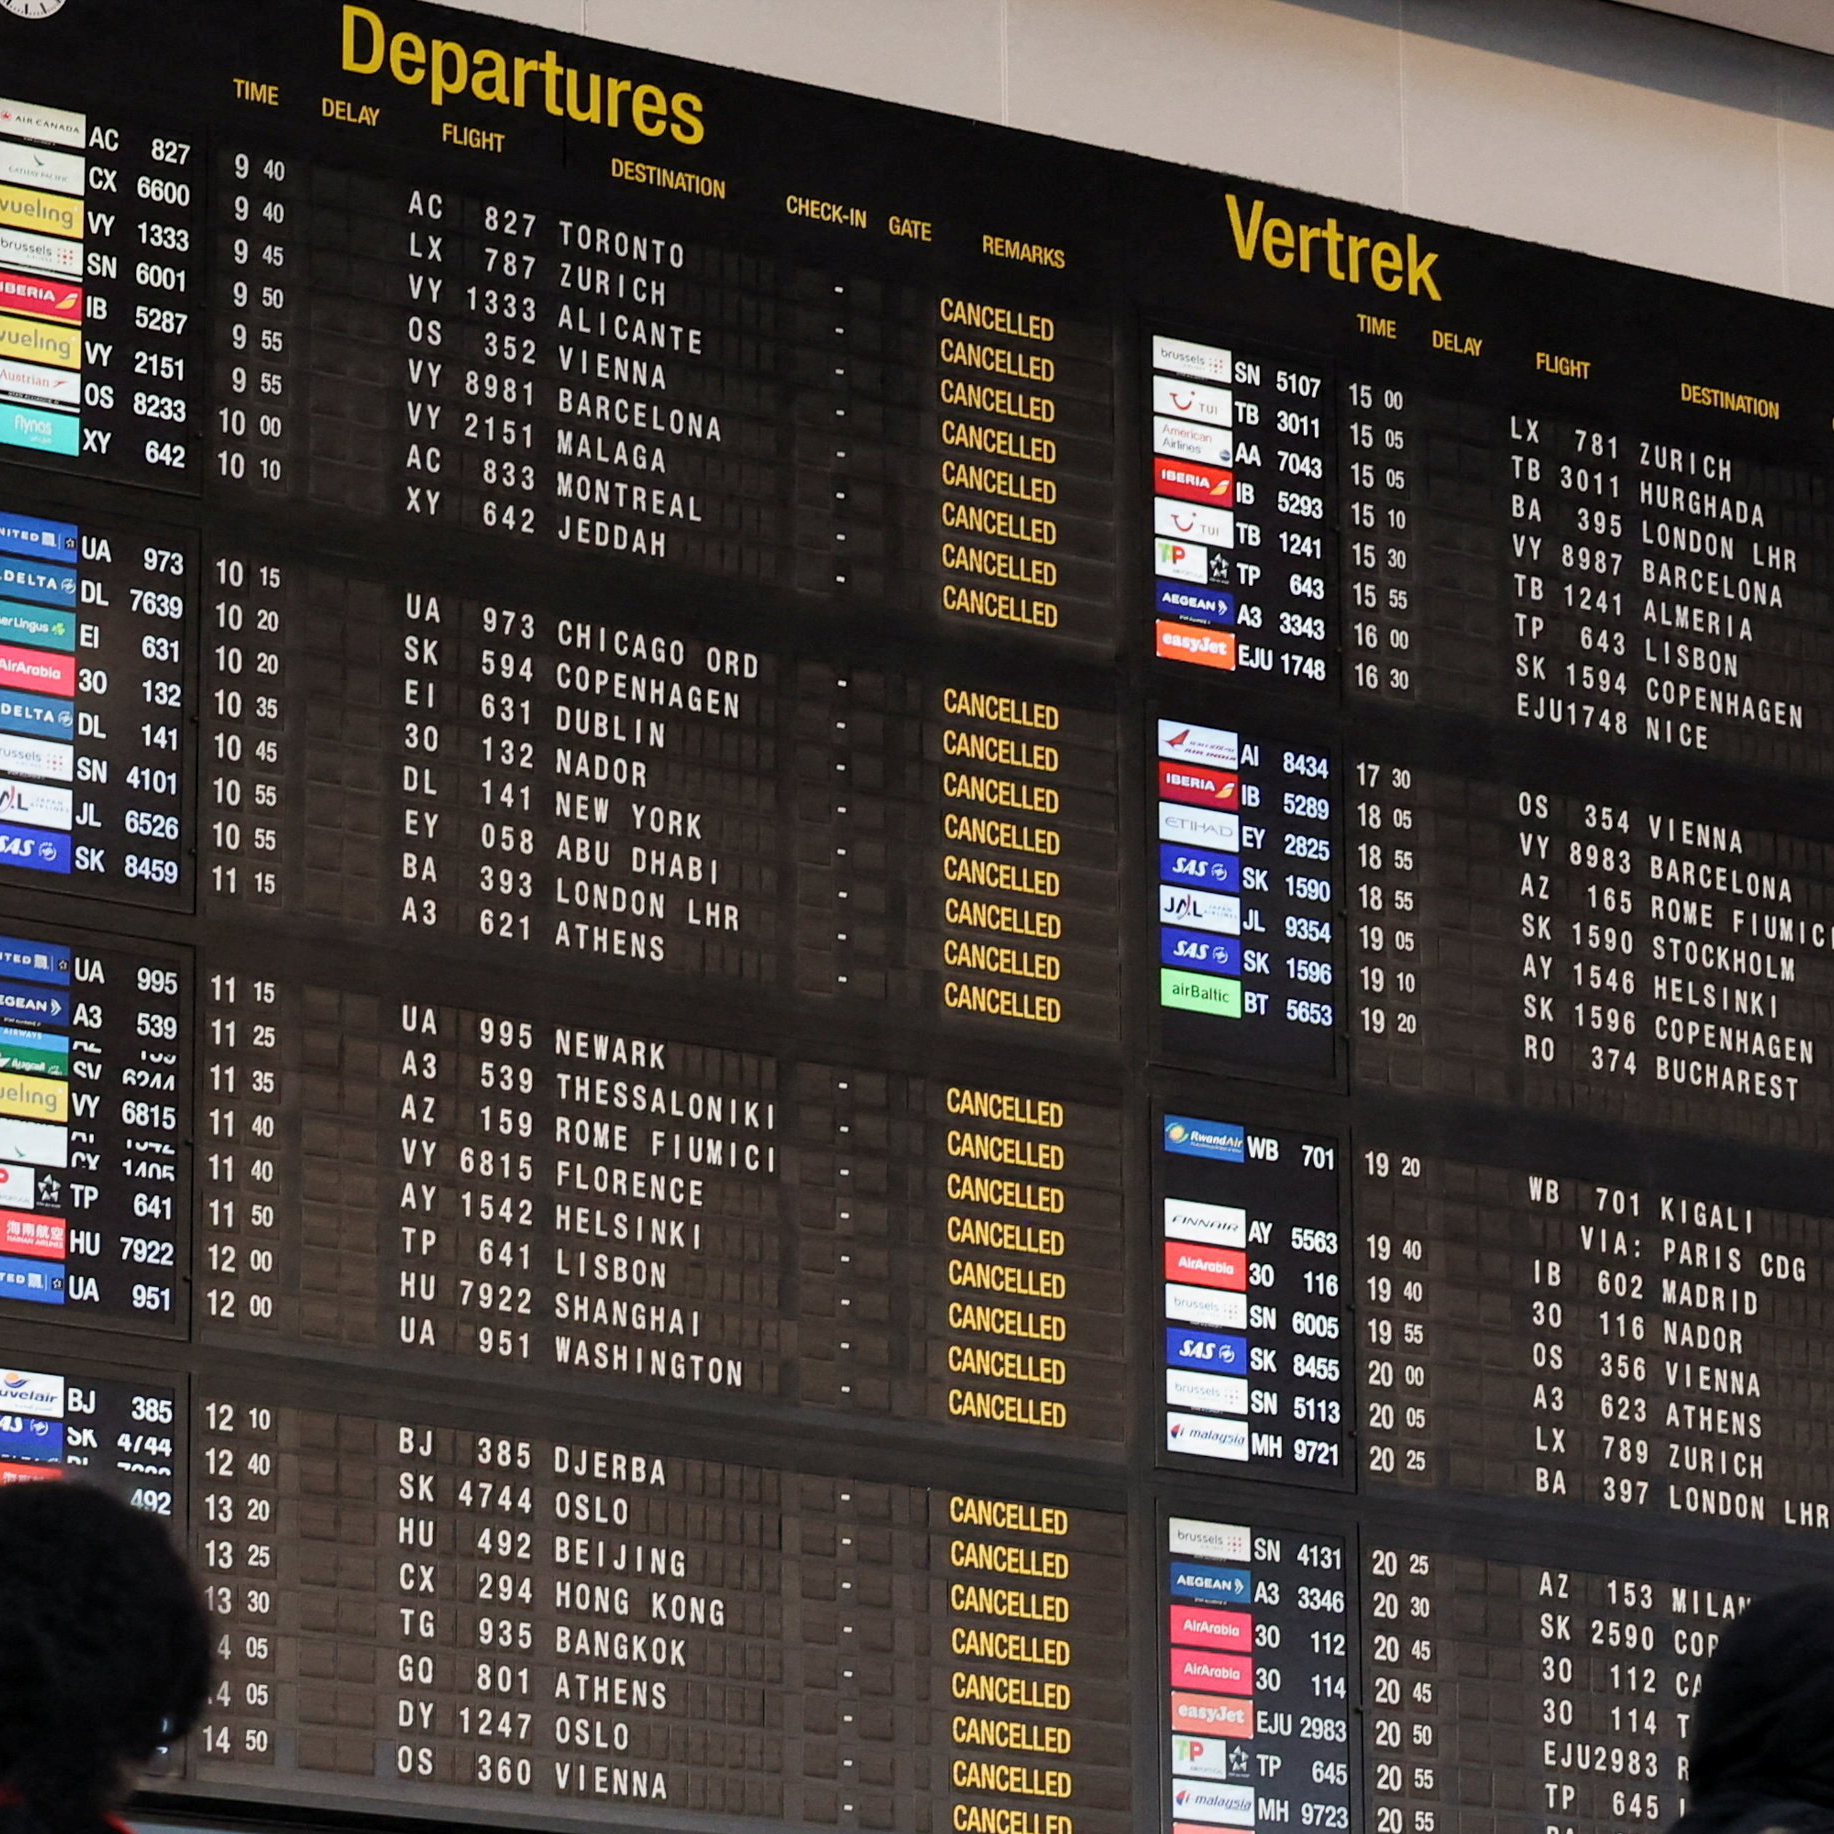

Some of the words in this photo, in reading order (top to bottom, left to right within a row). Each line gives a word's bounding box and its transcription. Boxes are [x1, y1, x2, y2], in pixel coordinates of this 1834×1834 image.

[343, 5, 704, 144] Departures
[89, 127, 118, 151] AC
[152, 139, 190, 164] 827
[233, 79, 278, 105] TIME
[322, 98, 379, 126] DELAY
[443, 123, 505, 152] FLIGHT
[612, 158, 725, 199] DESTINATION
[787, 195, 866, 228] CHECK-IN
[889, 216, 931, 241] GATE
[983, 235, 1065, 268] REMARKS
[0, 198, 74, 229] vueling
[0, 238, 52, 257] brussels
[235, 154, 248, 178] 9
[264, 160, 284, 181] 40
[409, 191, 442, 219] AC
[486, 206, 535, 237] 827
[559, 221, 683, 268] TORONTO
[941, 298, 1053, 341] CANCELLED
[1225, 194, 1441, 301] Vertrek
[0, 281, 55, 302] IBERIA
[561, 263, 664, 306] ZURICH
[559, 305, 701, 354] ALICANTE
[559, 346, 665, 389] VIENNA
[1357, 314, 1396, 339] TIME
[1433, 330, 1482, 356] DELAY
[1537, 352, 1590, 379] FLIGHT
[1681, 383, 1779, 419] DESTINATION
[559, 388, 720, 441] BARCELONA
[558, 430, 665, 473] MALAGA
[1641, 442, 1730, 482] ZURICH
[558, 472, 701, 521] MONTREAL
[1641, 481, 1763, 527] HURGHADA
[558, 516, 664, 557] JEDDAH
[4, 569, 57, 590] DELTA
[1644, 599, 1752, 641] ALMERIA
[1162, 632, 1227, 656] easyJet
[1646, 638, 1737, 677] LISBON
[557, 663, 738, 718] COPENHAGEN
[559, 620, 683, 665] CHICAGO
[708, 647, 757, 678] ORD
[944, 689, 1058, 730] CANCELLED
[1518, 693, 1626, 734] EJU1748
[1647, 717, 1707, 749] NICE
[1647, 678, 1801, 728] COPENHAGEN
[557, 706, 664, 747] DUBLIN
[557, 749, 645, 787] NADOR
[556, 791, 608, 823] NEW
[632, 804, 701, 839] YORK
[1165, 817, 1233, 837] ETIHAD
[557, 835, 608, 866] ABU
[633, 847, 716, 884] DHABI
[557, 878, 664, 918] LONDON
[689, 899, 738, 931] LHR
[556, 921, 663, 961] ATHENS
[1653, 936, 1794, 981] STOCKHOLM
[1172, 982, 1229, 1003] airBaltic
[556, 1029, 664, 1069] NEWARK
[947, 1088, 1063, 1127] CANCELLED
[1657, 1056, 1798, 1101] BUCHAREST
[557, 1073, 773, 1129] THESSALONIKI
[556, 1117, 627, 1151] ROME
[653, 1131, 773, 1172] FIUMICI
[402, 1138, 436, 1166] VY
[461, 1147, 531, 1181] 6815
[558, 1161, 702, 1206] FLORENCE
[557, 1205, 699, 1249] HELSINKI
[1661, 1197, 1751, 1233] KIGALI
[558, 1249, 665, 1288] LISBON
[1581, 1226, 1639, 1257] VIA:
[1664, 1238, 1740, 1272] PARIS
[1761, 1253, 1805, 1281] CDG
[556, 1292, 698, 1336] SHANGHAI
[1663, 1279, 1757, 1315] MADRID
[556, 1336, 741, 1386] WASHINGTON
[555, 1446, 664, 1485] DJERBA
[556, 1492, 627, 1524] OSLO
[556, 1536, 684, 1577] BEIJING
[556, 1581, 628, 1615] HONG
[653, 1592, 723, 1625] KONG
[557, 1627, 685, 1666] BANGKOK
[203, 1726, 230, 1753] 14
[246, 1730, 267, 1752] 50
[556, 1763, 666, 1799] VIENNA
[1545, 1741, 1657, 1777] EJU2983
[1195, 1793, 1251, 1811] malaysia
